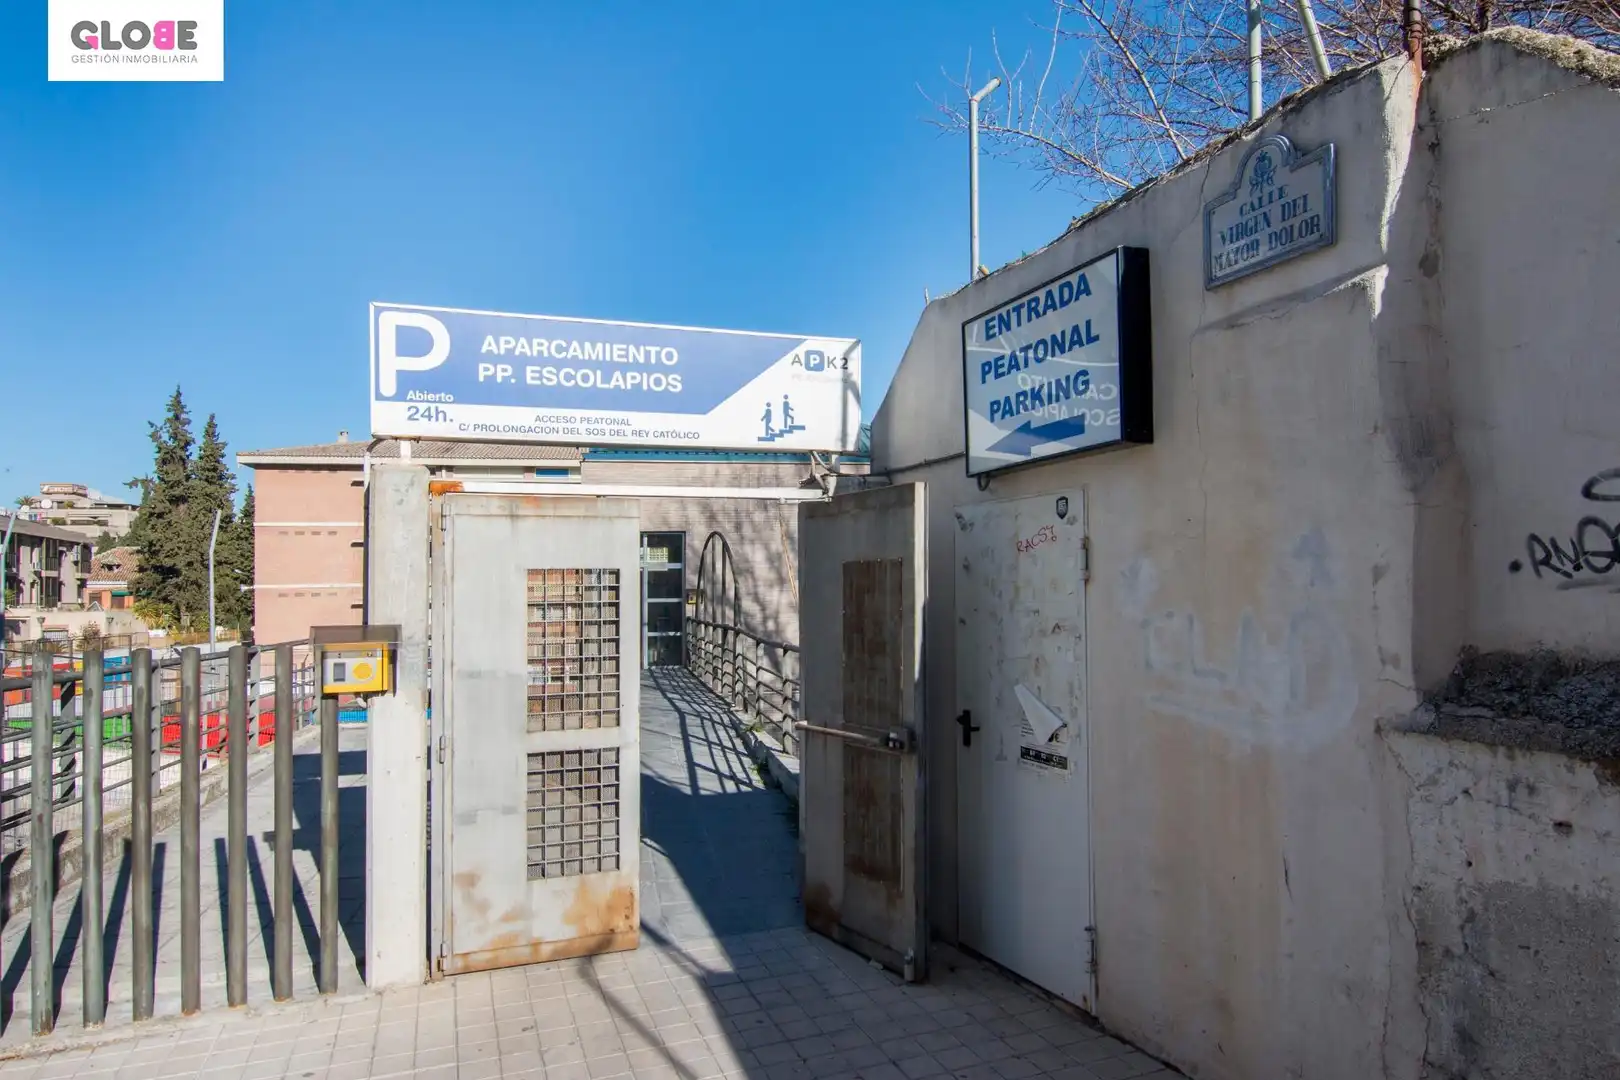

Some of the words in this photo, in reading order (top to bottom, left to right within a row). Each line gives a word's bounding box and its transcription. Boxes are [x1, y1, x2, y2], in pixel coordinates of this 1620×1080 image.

[1239, 184, 1290, 218] CALLE
[1219, 208, 1272, 246] VIRGEN
[1280, 193, 1312, 223] DEL
[1212, 237, 1260, 273] MAYOR
[1268, 213, 1321, 251] DOLOR
[985, 271, 1092, 342] ENTRADA
[378, 310, 451, 398] P
[480, 335, 679, 366] APARCAMIENTO
[981, 318, 1100, 384] PEATONAL
[478, 363, 516, 384] PP.
[526, 366, 683, 393] ESCOLAPIOS
[406, 390, 454, 403] Abierto
[989, 369, 1090, 423] PARKING
[407, 405, 454, 423] 24h.
[534, 414, 577, 425] ACCESO
[580, 416, 633, 427] PEATONAL
[458, 422, 469, 432] C/
[473, 423, 560, 435] PROLONGACION
[562, 426, 582, 436] DEL
[585, 427, 606, 437] SOS
[609, 428, 628, 438] DEL
[631, 429, 650, 439] REY
[652, 429, 700, 441] CATÓLICO
